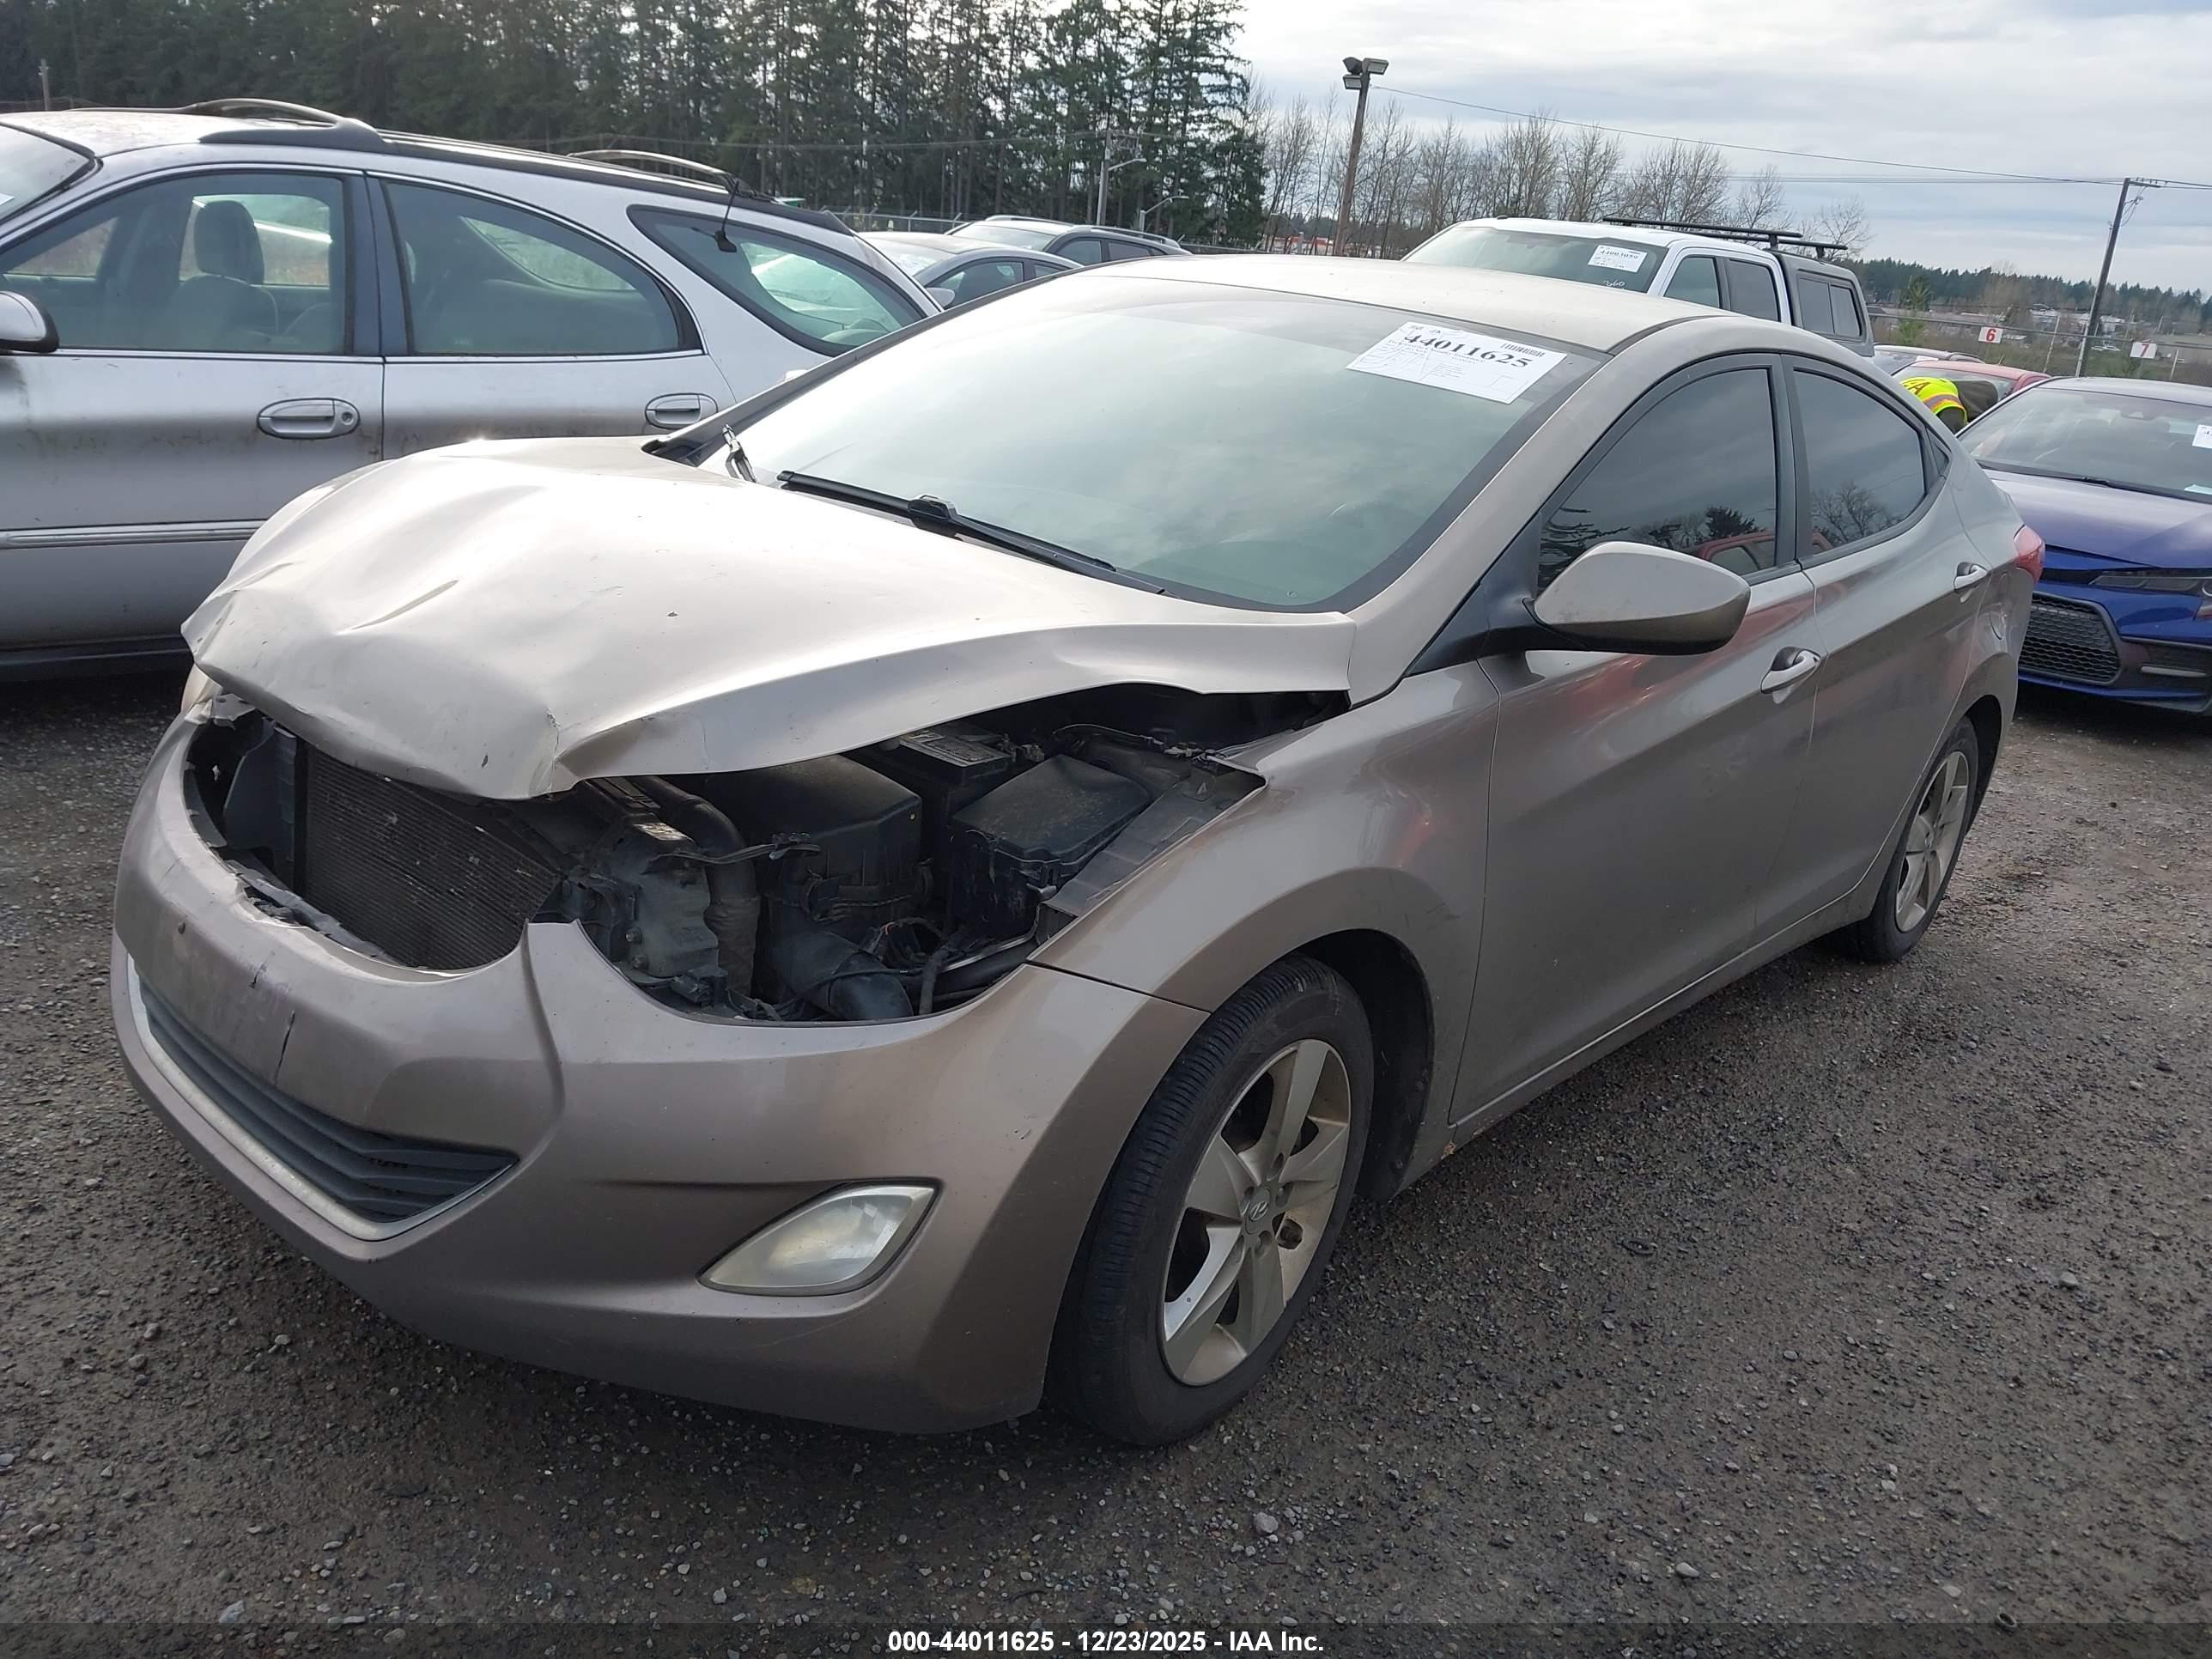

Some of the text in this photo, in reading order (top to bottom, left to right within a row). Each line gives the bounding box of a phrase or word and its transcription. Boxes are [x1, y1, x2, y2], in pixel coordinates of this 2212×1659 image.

[1986, 328, 1996, 342] 6
[1404, 334, 1533, 368] 44011625
[2141, 343, 2148, 357] 7
